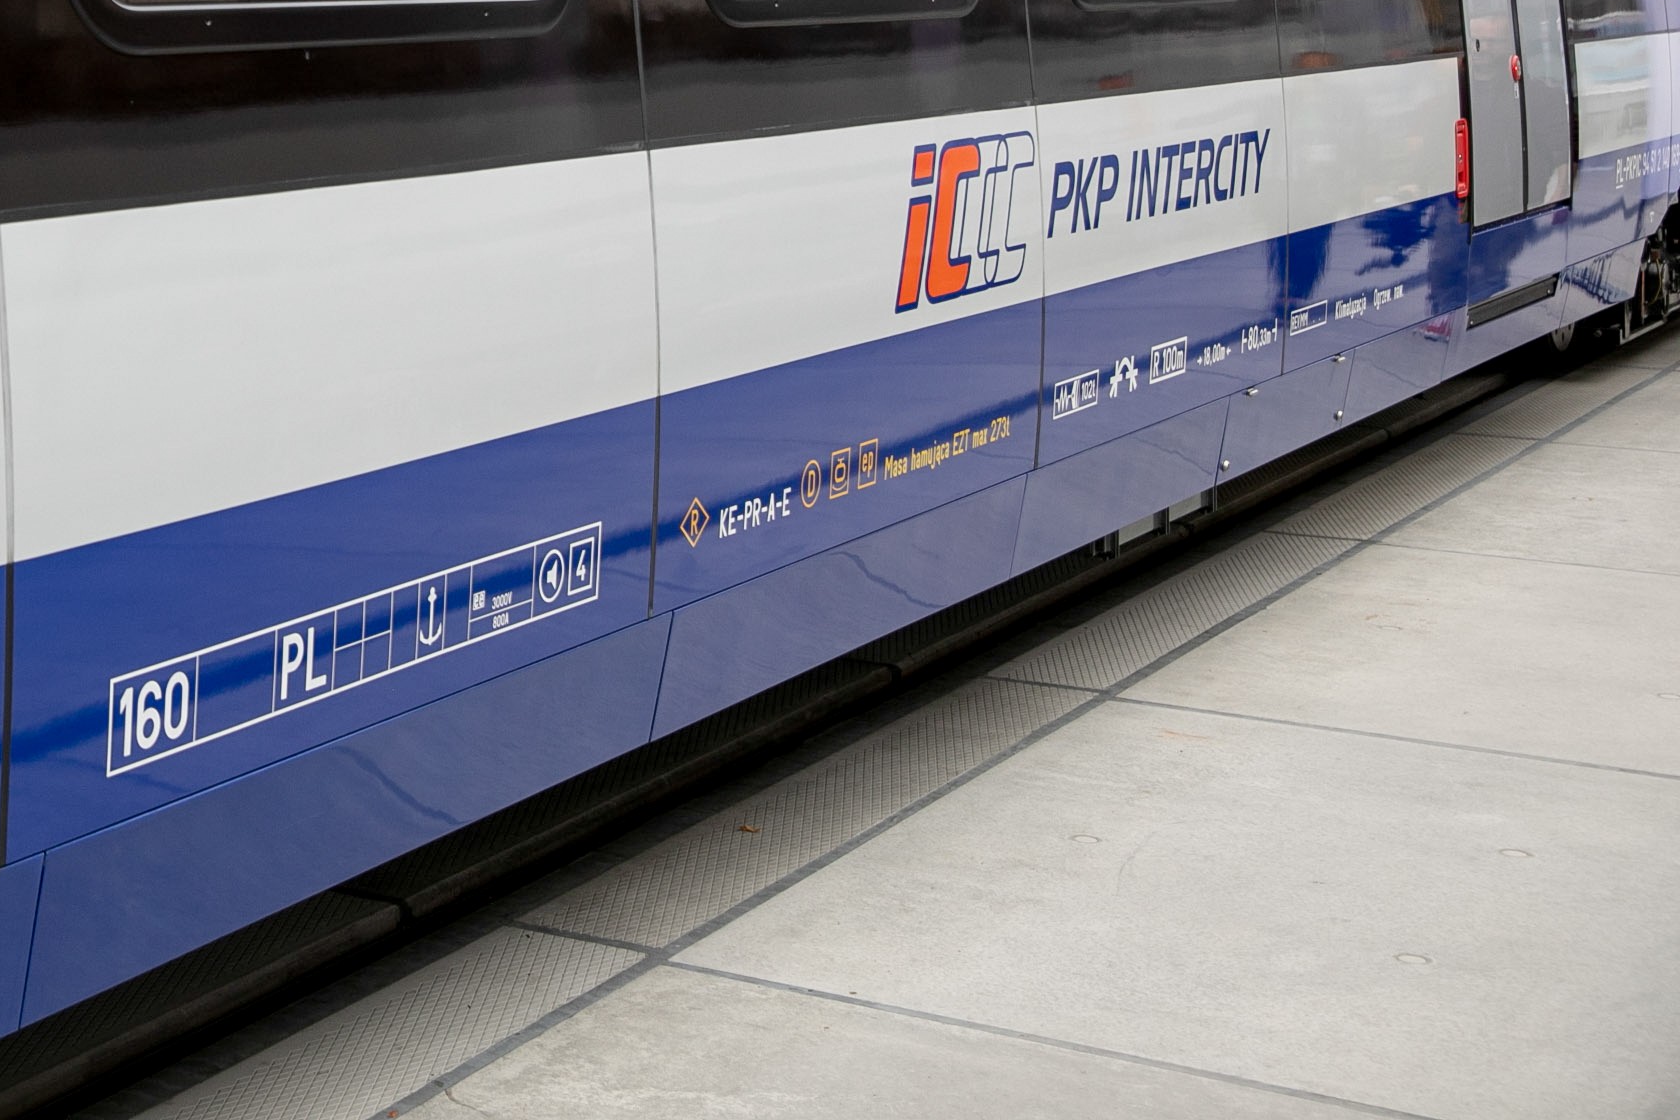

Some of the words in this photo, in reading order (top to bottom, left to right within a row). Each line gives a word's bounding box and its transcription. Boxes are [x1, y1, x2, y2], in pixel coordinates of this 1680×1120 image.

[1047, 153, 1120, 238] PKP
[1126, 128, 1271, 222] INTERCITY
[1335, 292, 1367, 320] Klimatyzacja
[1152, 358, 1160, 378] R
[1162, 345, 1184, 373] 100m
[1081, 379, 1096, 401] 102t
[883, 455, 908, 481] Masa
[910, 439, 950, 470] hamująca
[952, 428, 971, 456] EZT
[972, 428, 989, 449] max
[990, 415, 1011, 443] 273t
[861, 452, 875, 478] ep
[806, 469, 817, 499] D
[690, 509, 700, 537] R
[718, 487, 792, 539] KE-PR-A-E
[575, 549, 587, 582] 4
[491, 591, 513, 610] 3000V
[280, 627, 328, 702] PL
[119, 670, 190, 757] 160
